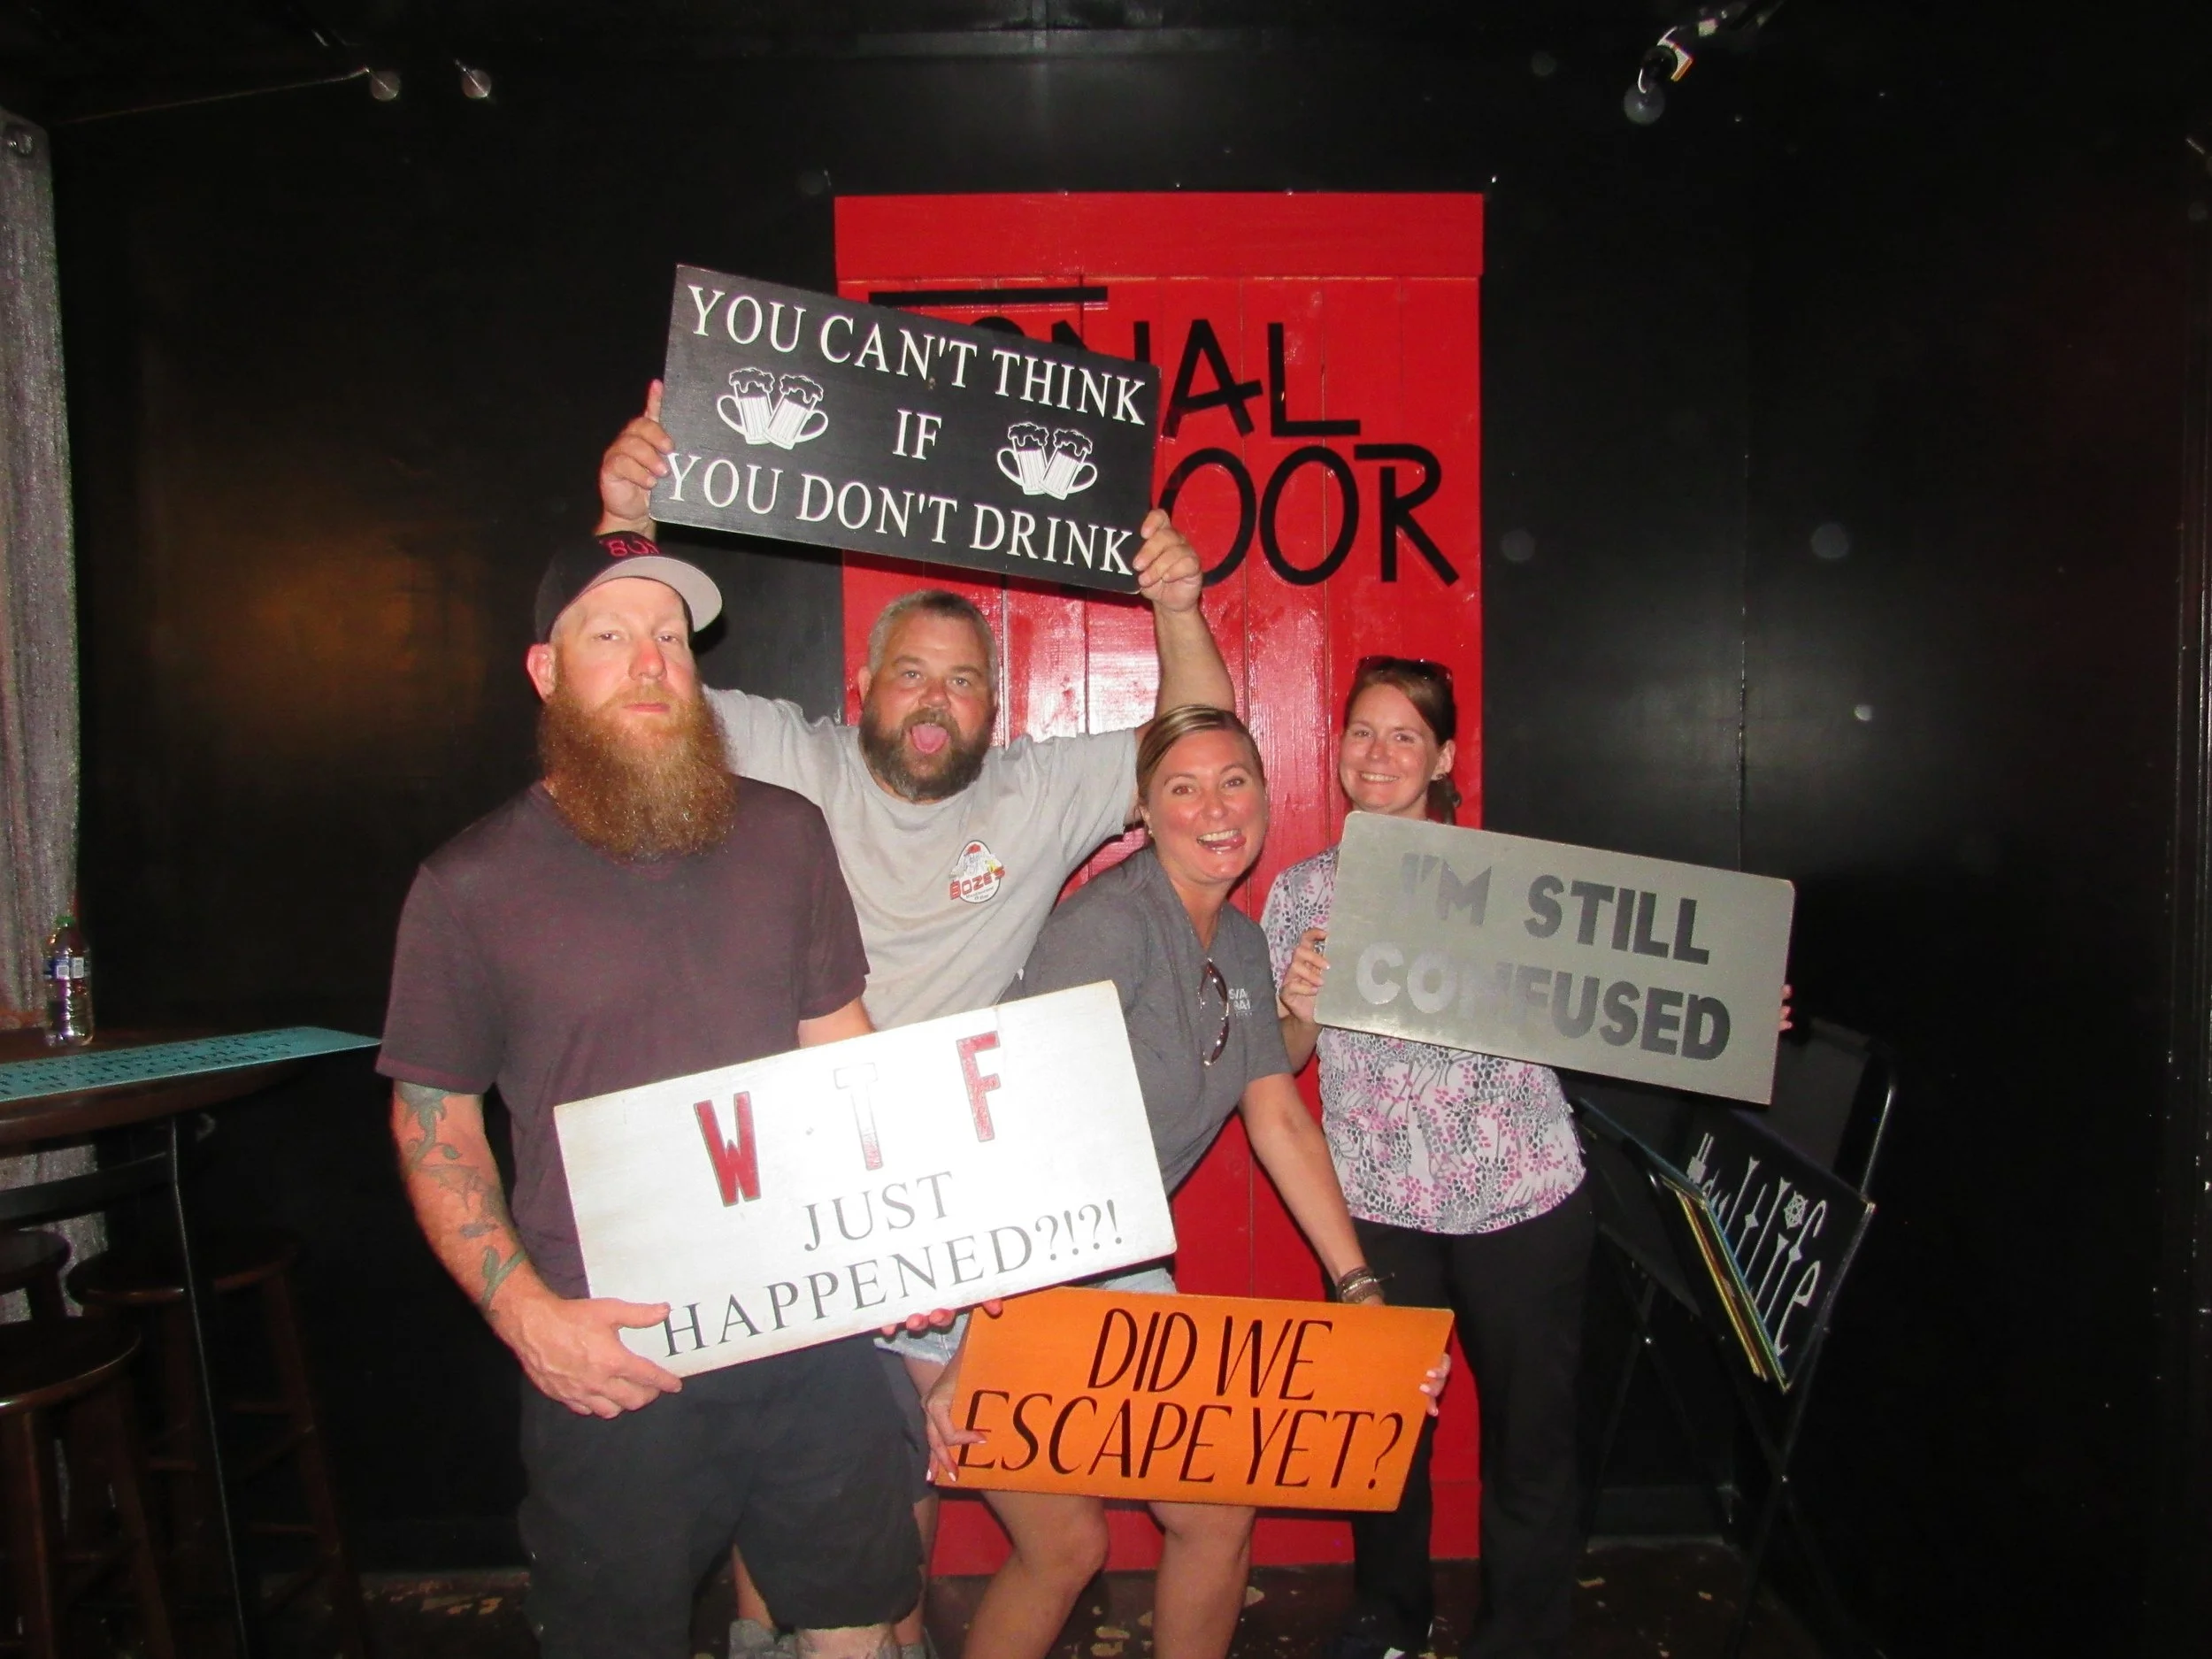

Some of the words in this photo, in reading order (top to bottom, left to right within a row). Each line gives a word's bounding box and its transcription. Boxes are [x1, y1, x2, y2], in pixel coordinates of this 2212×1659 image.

[687, 285, 806, 353] YOU
[820, 314, 978, 388] CAN'T
[993, 349, 1148, 426] THINK
[893, 409, 942, 461] IF
[666, 453, 784, 515] YOU
[800, 473, 957, 544] DON'T
[972, 503, 1135, 577] DRINK
[1159, 442, 1460, 587] OOR
[1400, 852, 1493, 927] I'M
[1524, 874, 1710, 965] STILL
[803, 1171, 954, 1251] JUST
[664, 1199, 1123, 1357] HAPPENED?!?!
[1087, 1308, 1198, 1394] DID
[1216, 1315, 1333, 1401] WE
[957, 1390, 1233, 1483] ESCAPE
[1246, 1407, 1403, 1490] YET?
